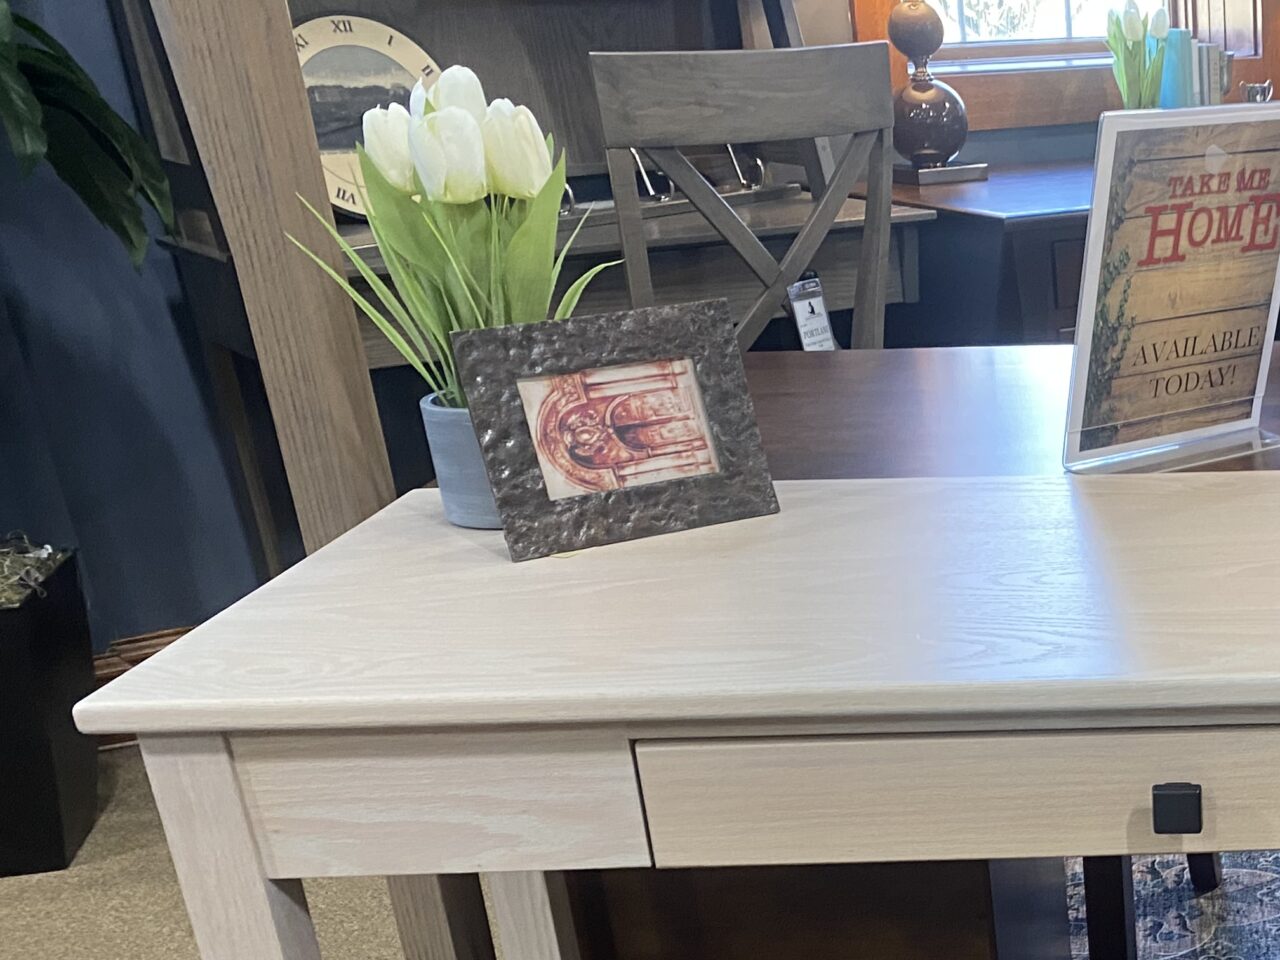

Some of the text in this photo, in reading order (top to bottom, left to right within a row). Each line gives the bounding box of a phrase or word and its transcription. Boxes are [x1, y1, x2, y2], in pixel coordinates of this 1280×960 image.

[330, 19, 353, 33] XII
[421, 64, 434, 77] II
[335, 186, 357, 206] VII
[1168, 167, 1271, 199] TAKE ME
[1131, 326, 1260, 366] AVAILABLE
[1149, 364, 1237, 399] TODAY!
